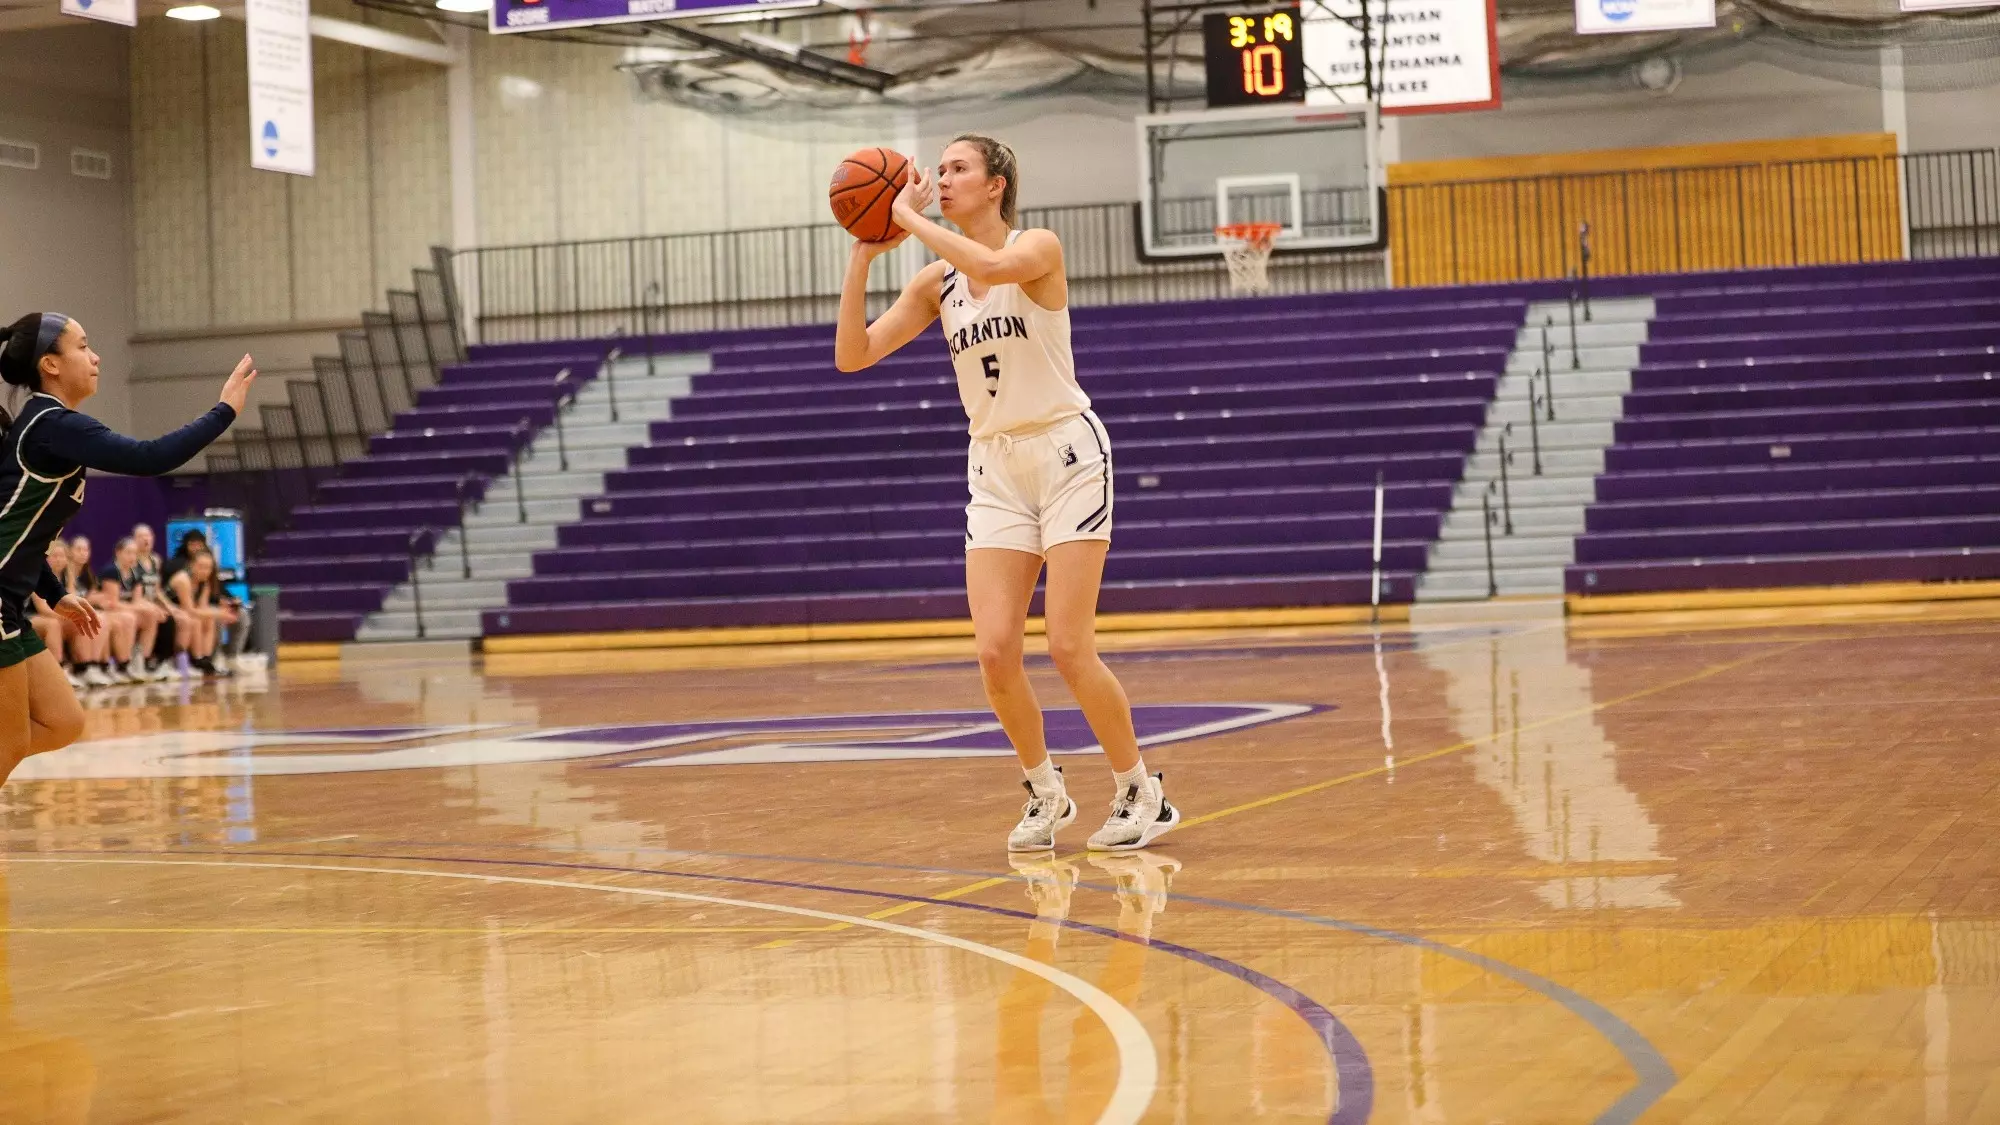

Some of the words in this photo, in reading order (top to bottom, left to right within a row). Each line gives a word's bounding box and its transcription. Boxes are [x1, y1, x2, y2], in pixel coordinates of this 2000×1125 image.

[1228, 12, 1293, 47] 3:19
[1350, 10, 1441, 29] RAVIAN
[1241, 44, 1283, 96] 10
[1329, 54, 1463, 76] SUSUEHANNA
[949, 315, 1029, 362] SCRANTON
[980, 353, 1001, 398] 5
